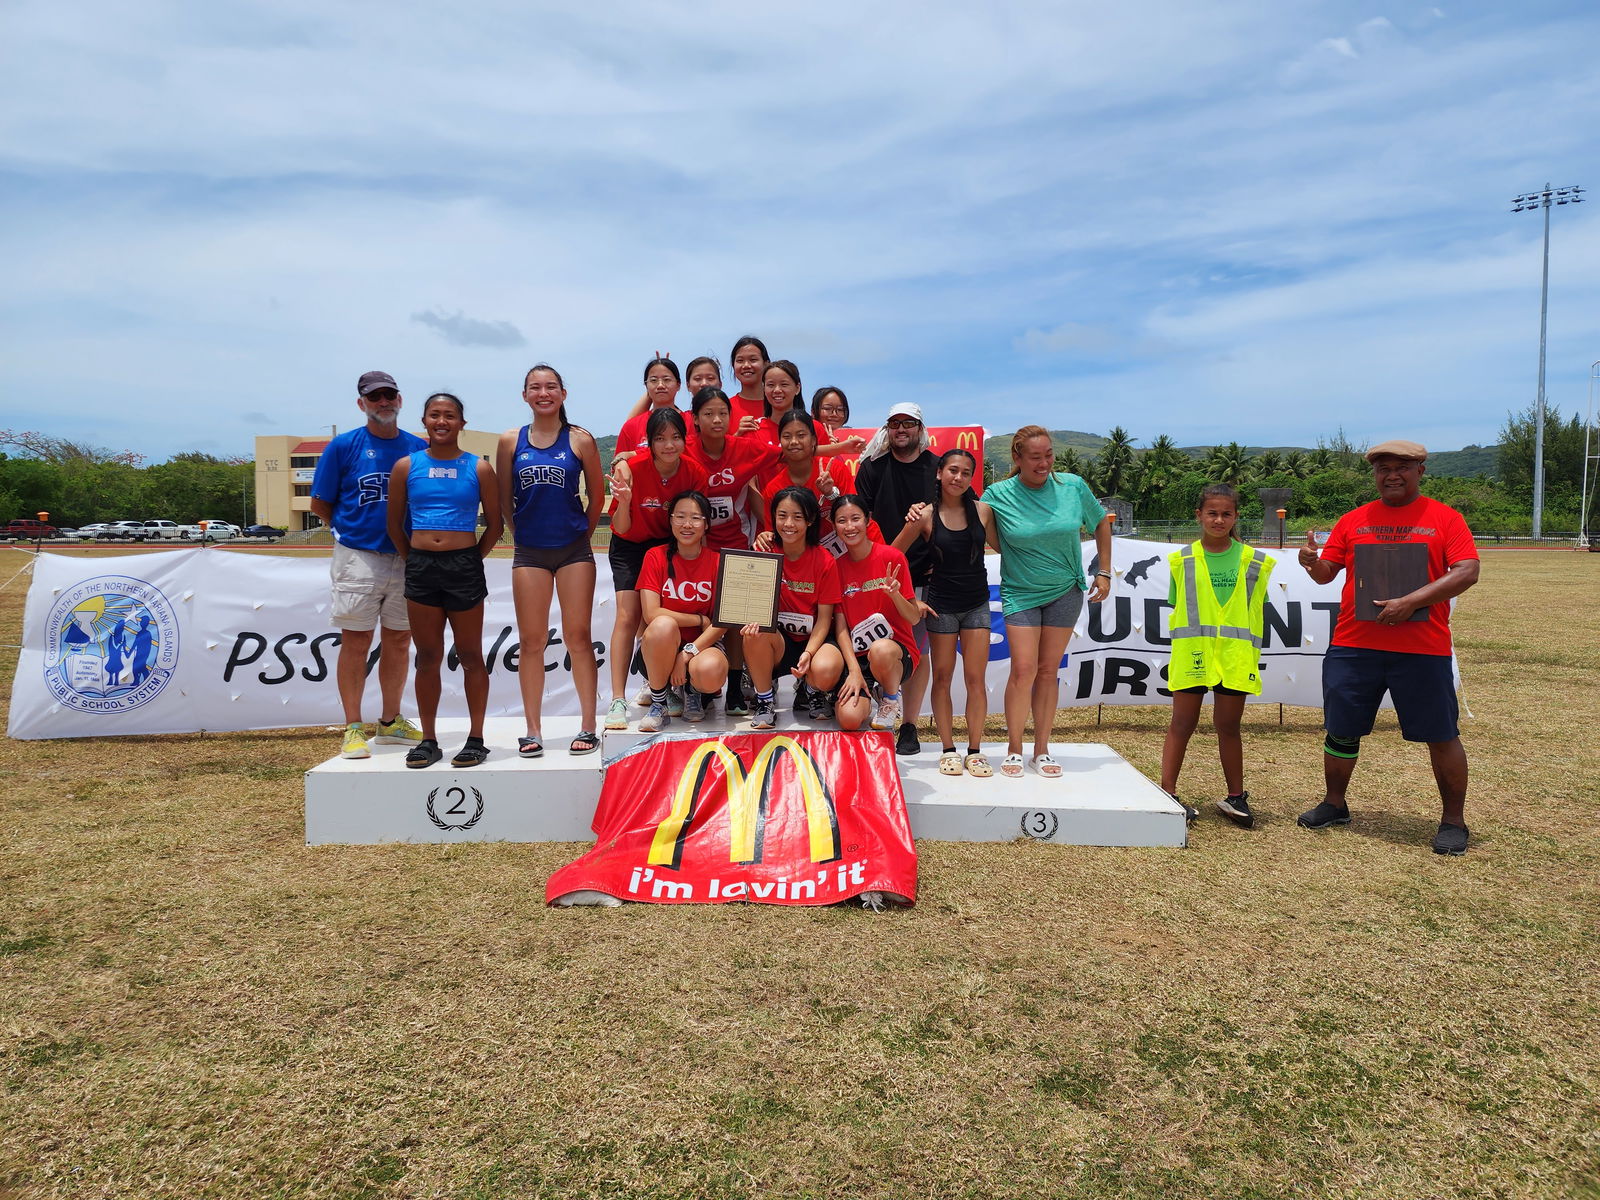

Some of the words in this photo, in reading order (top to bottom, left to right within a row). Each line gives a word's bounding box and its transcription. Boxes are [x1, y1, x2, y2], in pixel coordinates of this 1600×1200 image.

[428, 467, 458, 479] NMI
[518, 464, 565, 490] SIS
[708, 467, 735, 487] CS
[710, 505, 730, 520] 05
[661, 577, 712, 602] ACS
[48, 598, 73, 661] COMMONWEALTH
[72, 589, 84, 602] OF
[85, 583, 101, 594] THE
[104, 582, 149, 599] NORTHERN
[163, 626, 174, 663] ISLANDS
[854, 623, 889, 651] 310
[223, 631, 342, 685] PSS
[50, 678, 79, 704] PUBLIC
[81, 699, 126, 710] SCHOOL
[128, 677, 163, 705] SYSTEM
[445, 786, 466, 814] 2
[1032, 812, 1047, 833] 3
[628, 866, 694, 899] i'm
[708, 870, 827, 900] lovin'
[838, 861, 866, 893] it
